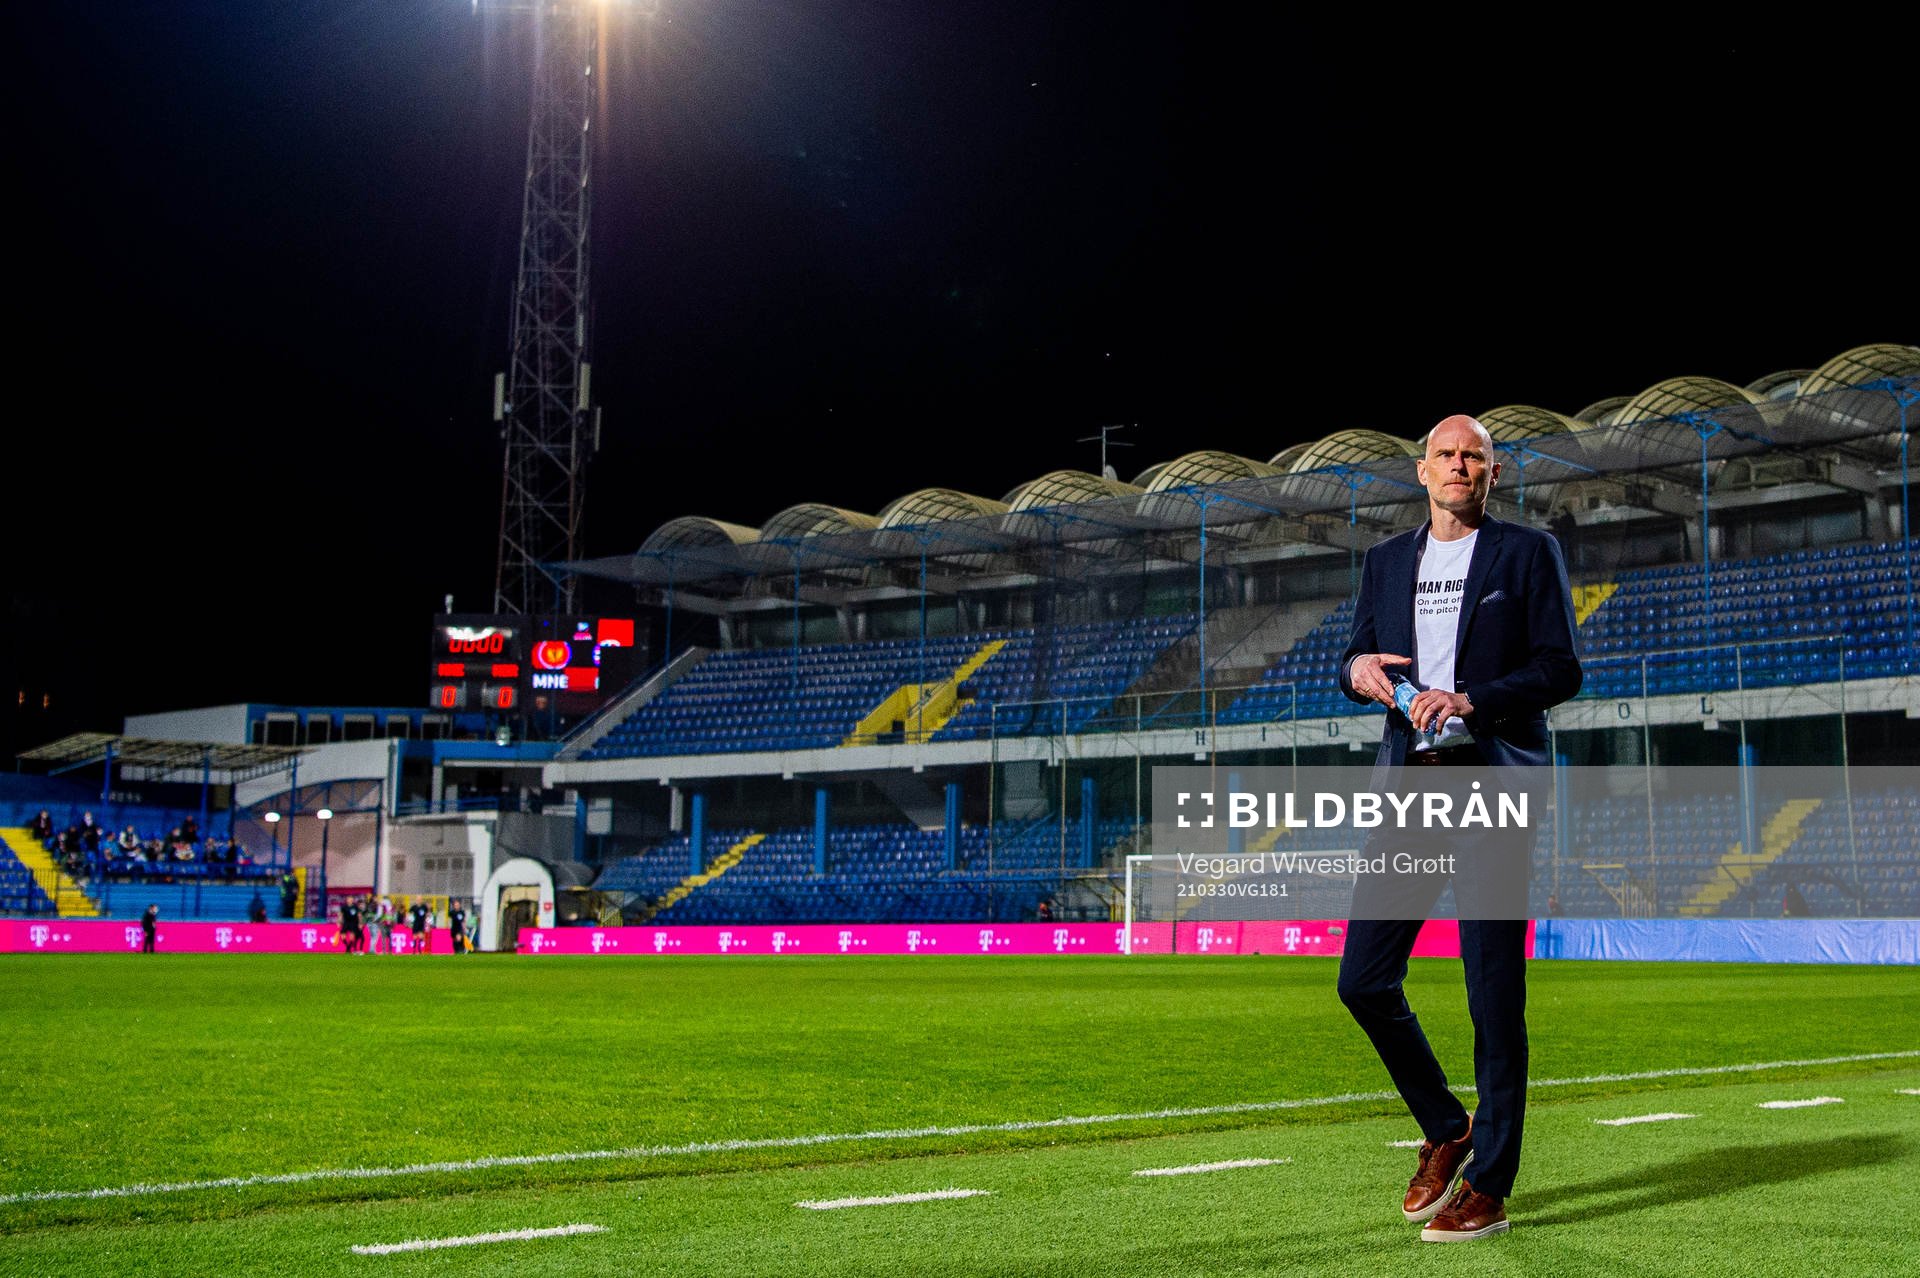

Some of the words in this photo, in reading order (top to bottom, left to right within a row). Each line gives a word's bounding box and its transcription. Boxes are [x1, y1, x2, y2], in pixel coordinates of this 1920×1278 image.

[1416, 581, 1442, 594] MAN
[1444, 579, 1465, 592] RIG
[1437, 606, 1458, 615] pitch
[532, 673, 569, 689] MNE
[441, 685, 456, 707] 0
[498, 685, 513, 707] 0
